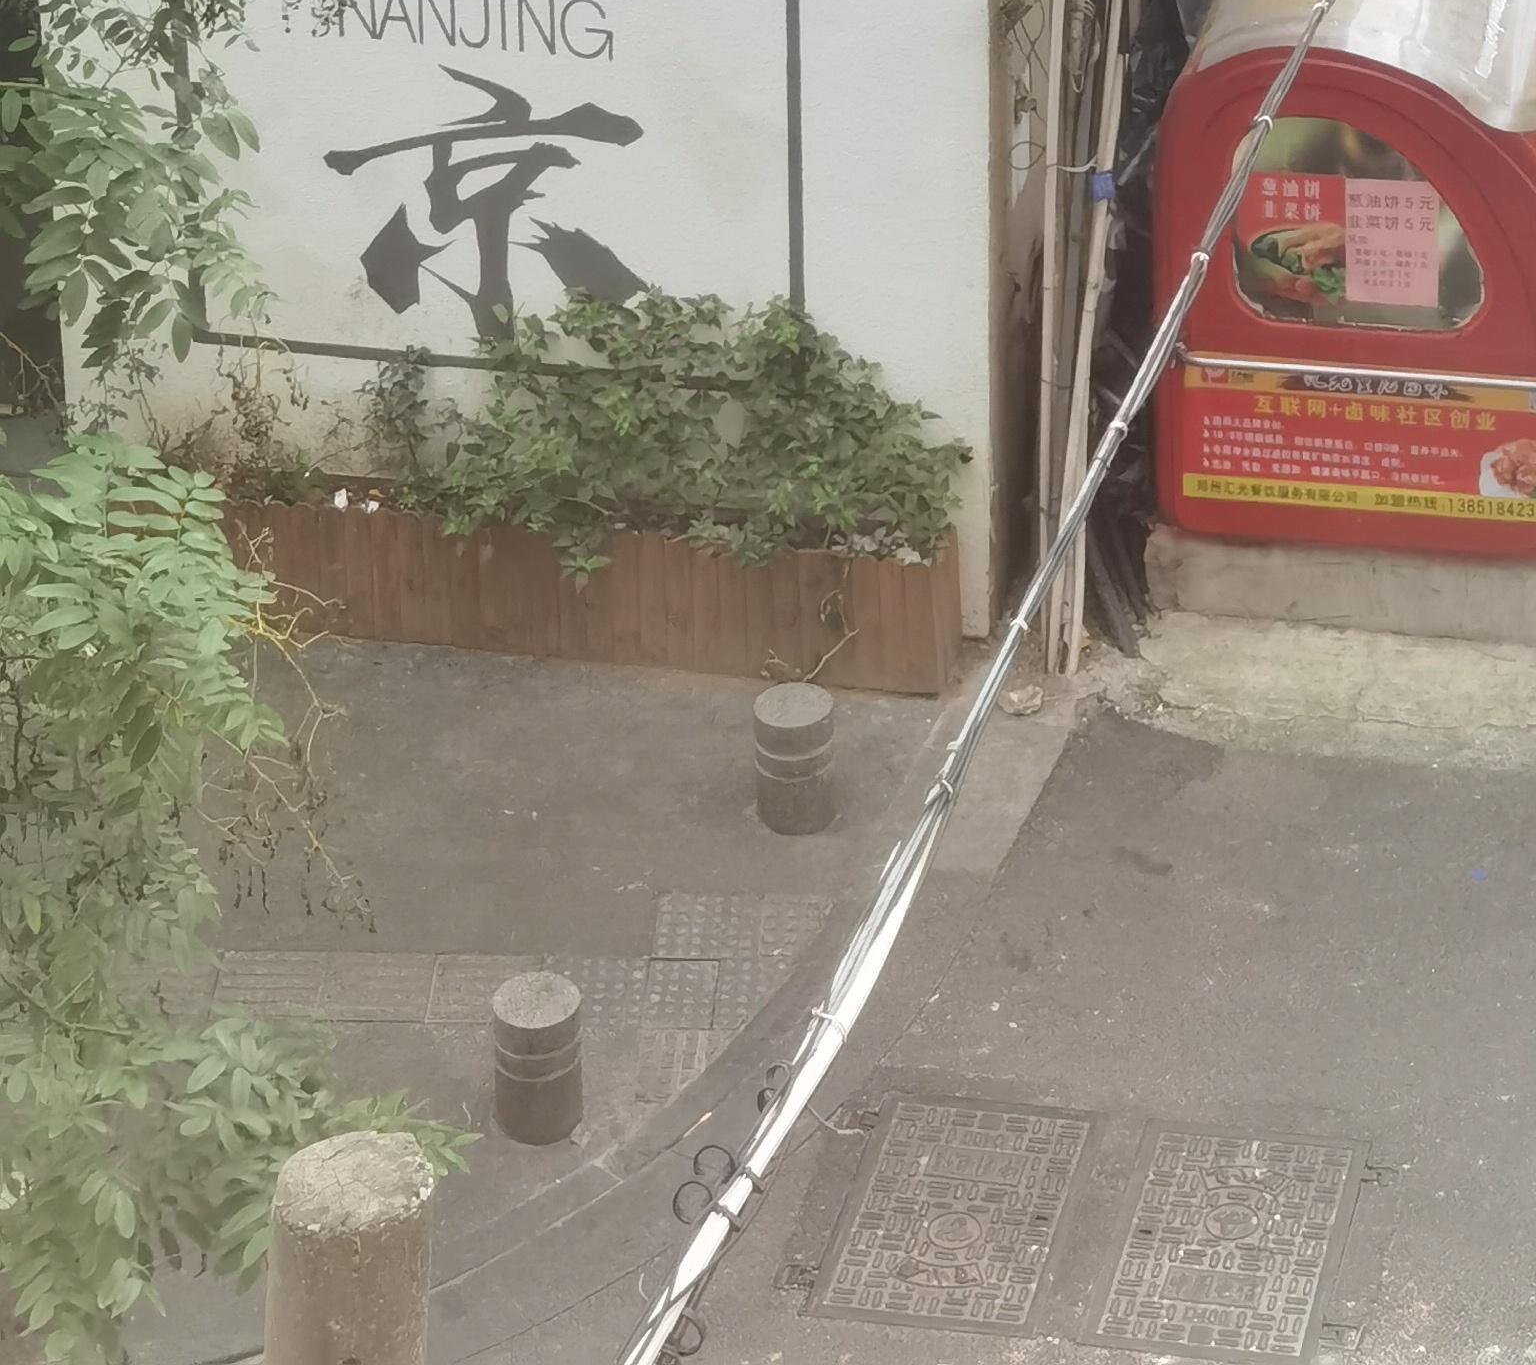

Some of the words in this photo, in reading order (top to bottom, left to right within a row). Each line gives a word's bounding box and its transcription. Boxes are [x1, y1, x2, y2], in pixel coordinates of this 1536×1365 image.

[324, 64, 650, 337] 京
[1254, 394, 1497, 431] 互联网+卤味社区创业
